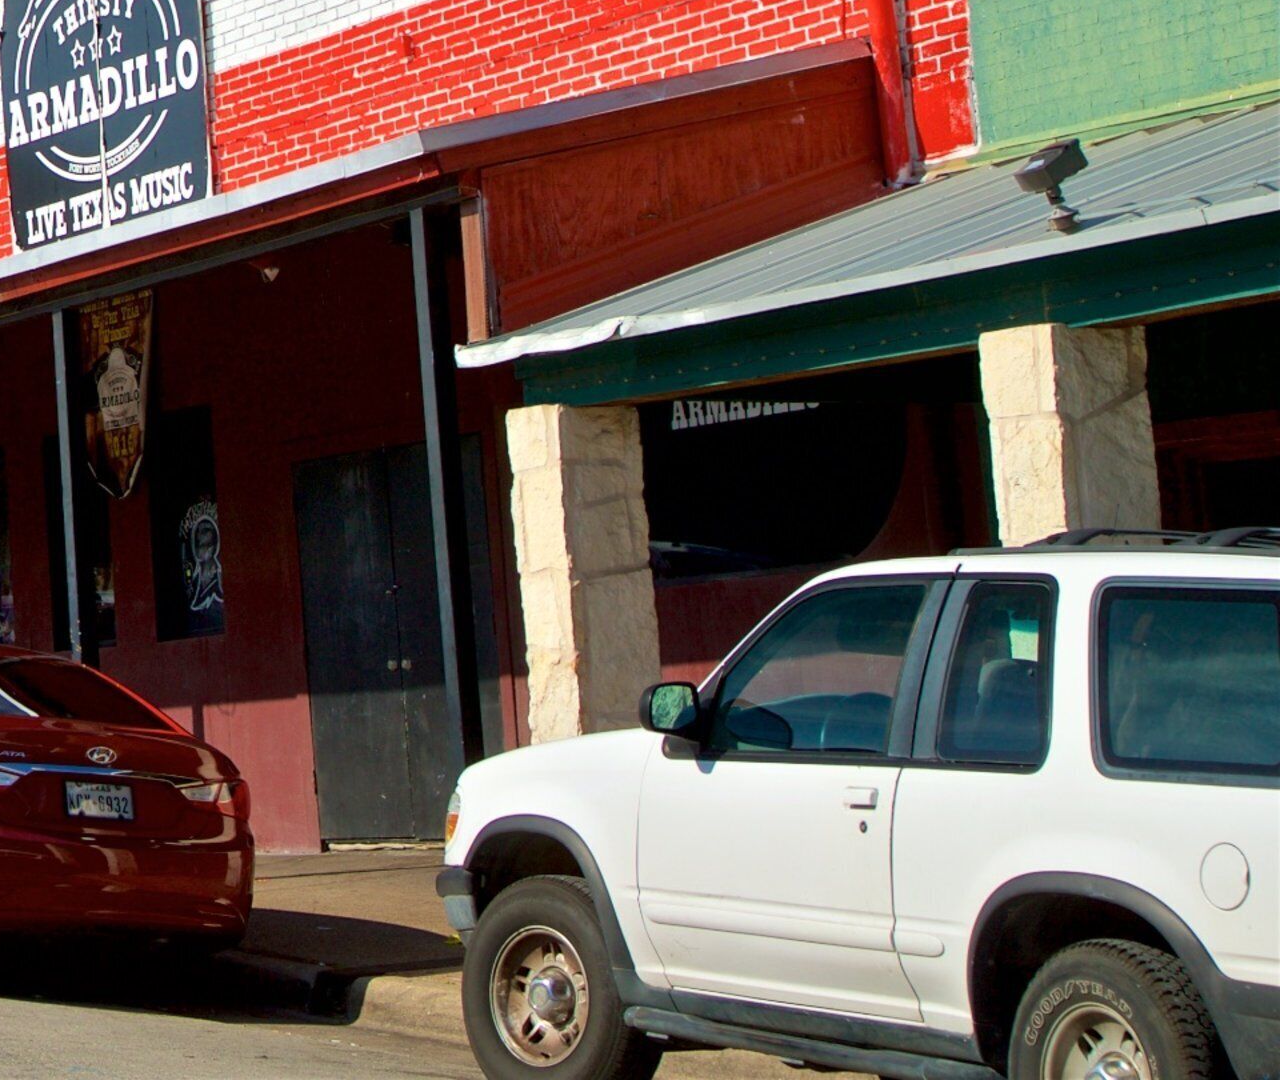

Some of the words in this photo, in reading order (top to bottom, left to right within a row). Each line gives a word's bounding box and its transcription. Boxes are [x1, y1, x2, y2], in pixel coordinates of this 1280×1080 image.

[8, 37, 200, 149] ARMADILLO
[25, 200, 67, 245] LIVE
[68, 178, 127, 230] TEXAS
[130, 161, 195, 216] MUSIC
